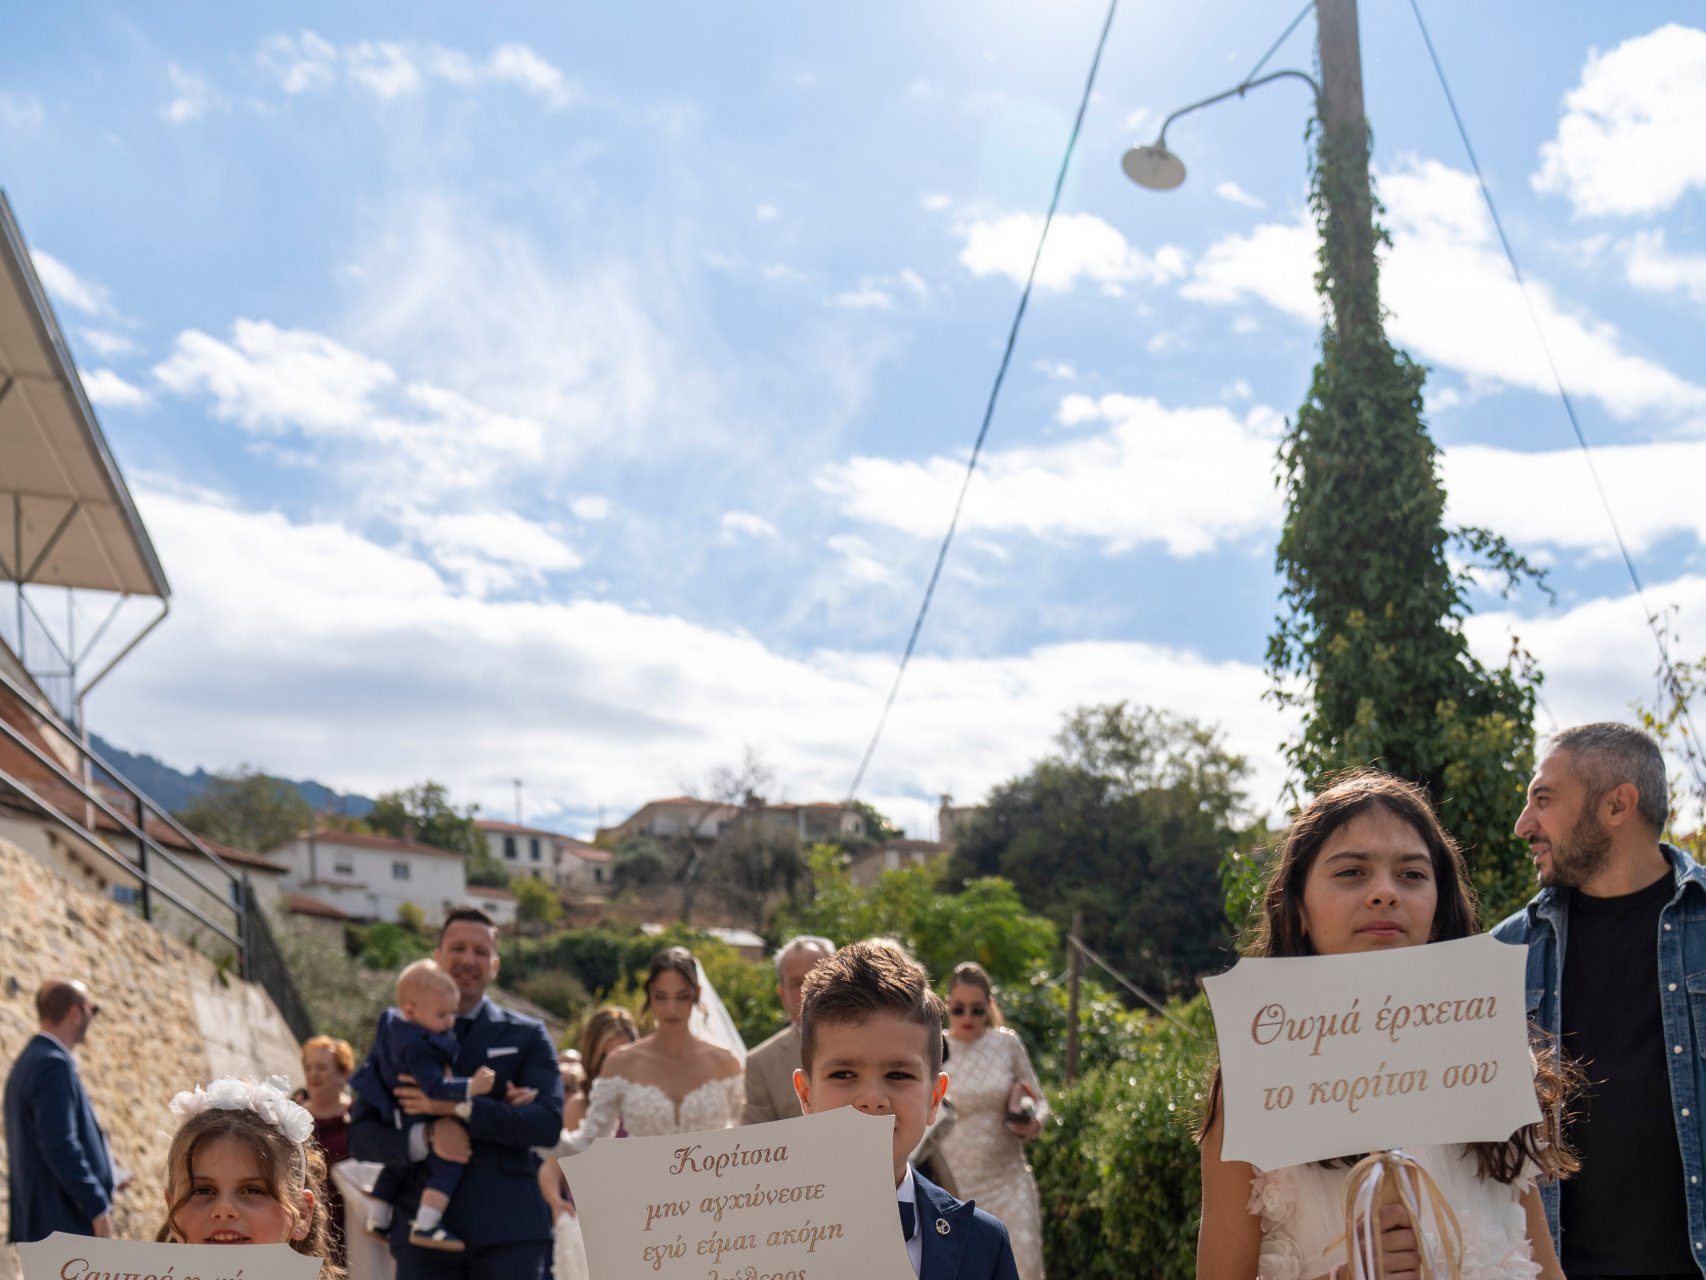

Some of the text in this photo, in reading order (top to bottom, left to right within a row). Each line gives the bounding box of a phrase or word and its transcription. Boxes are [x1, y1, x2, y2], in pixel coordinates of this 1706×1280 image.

[1251, 995, 1497, 1056] Θωμά έρχεται
[1264, 1061, 1498, 1113] το κορίτσι σου
[669, 1144, 788, 1178] Κορίτσια
[643, 1184, 825, 1231] μην αγχώνεστε
[643, 1220, 843, 1270] εγώ είμαι ακόμη
